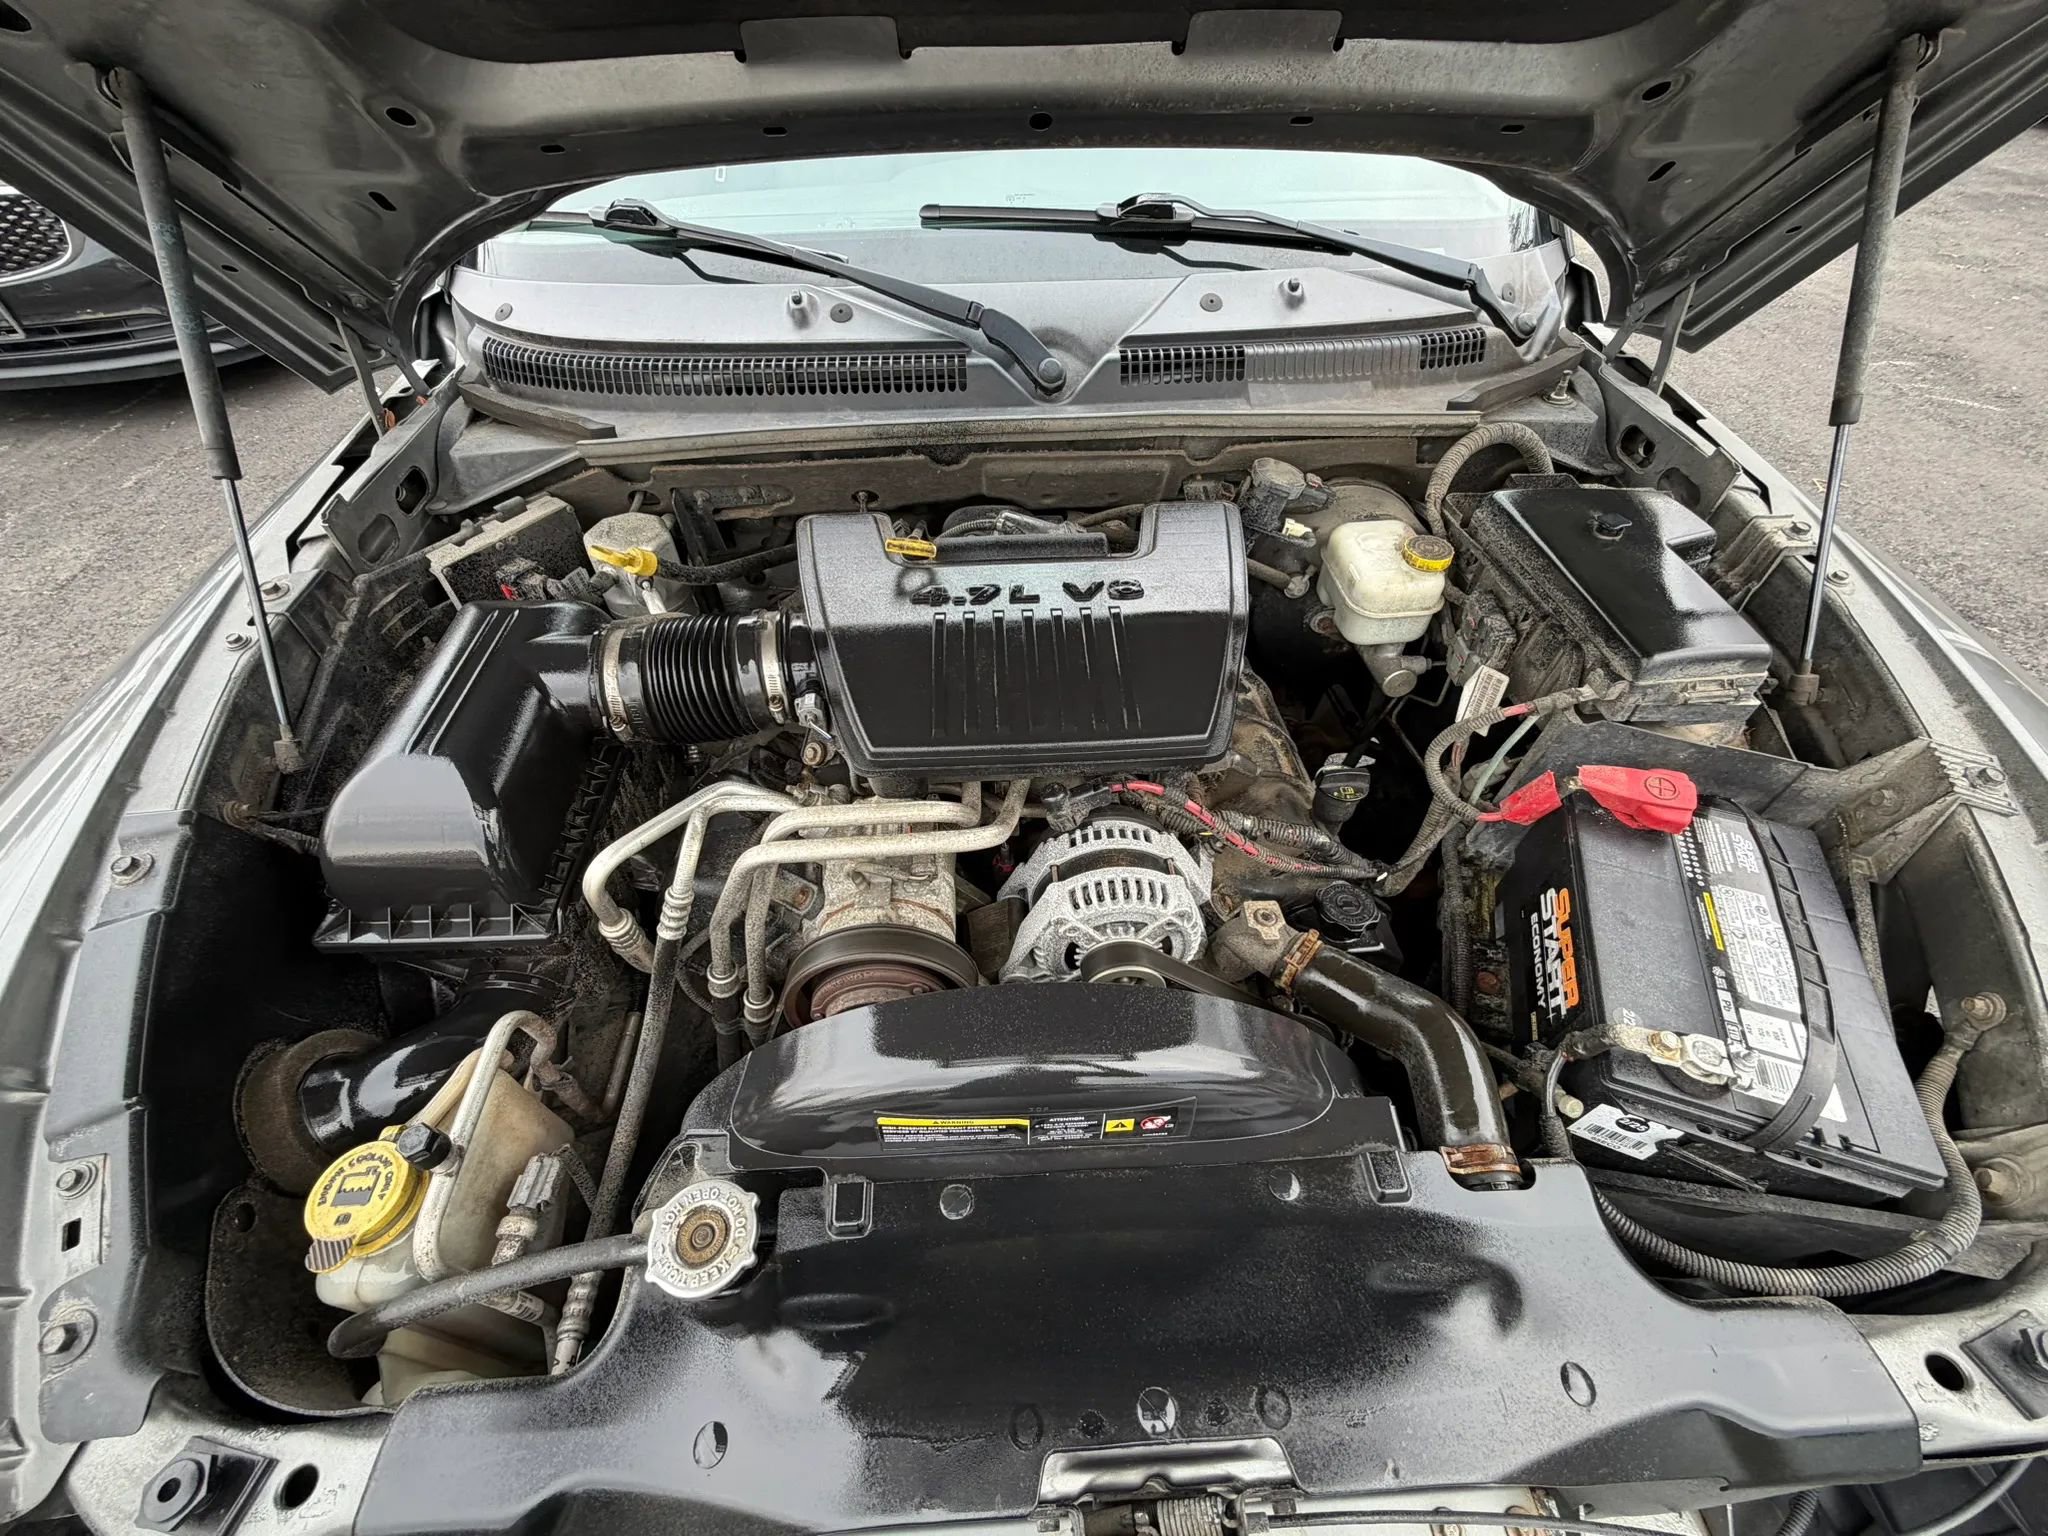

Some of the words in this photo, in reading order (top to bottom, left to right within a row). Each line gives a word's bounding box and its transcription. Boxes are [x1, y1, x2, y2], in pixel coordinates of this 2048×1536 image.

[909, 583, 1041, 607] 4.7L
[1062, 578, 1145, 601] V8
[1530, 913, 1548, 1009] ECONOMY
[1540, 888, 1567, 1020] START
[1554, 886, 1580, 1009] SUPER
[1617, 1116, 1650, 1132] 2/25
[347, 1152, 394, 1169] COOLANT
[682, 1187, 720, 1207] OPEN
[721, 1191, 744, 1215] NOT
[660, 1202, 684, 1233] HOT
[734, 1217, 748, 1238] DO
[689, 1258, 732, 1289] KEEP
